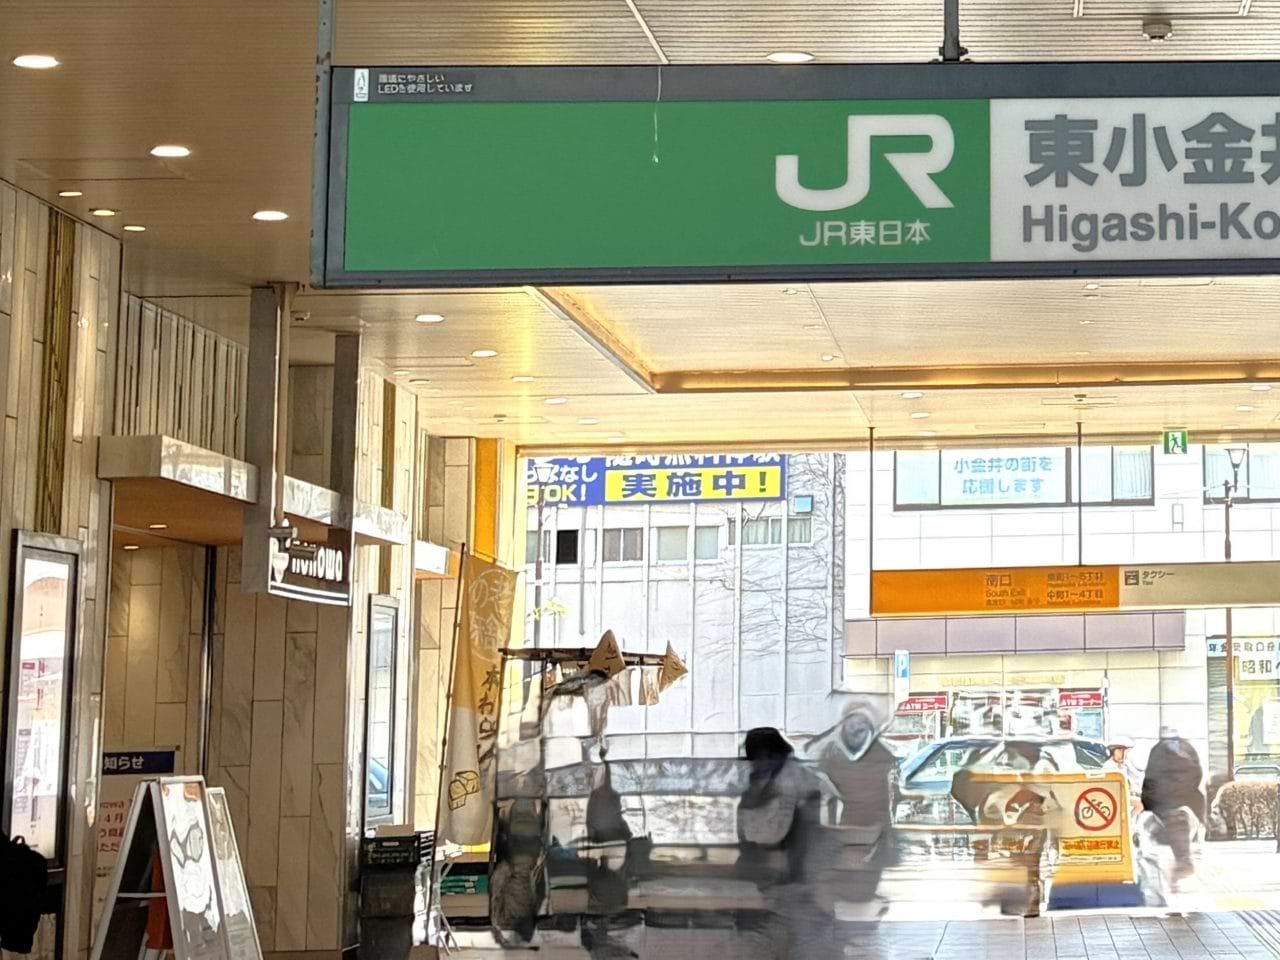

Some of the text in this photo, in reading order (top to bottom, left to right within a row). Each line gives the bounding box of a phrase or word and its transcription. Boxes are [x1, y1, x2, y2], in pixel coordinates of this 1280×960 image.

[774, 113, 956, 212] JR
[799, 218, 932, 247] JR東日本
